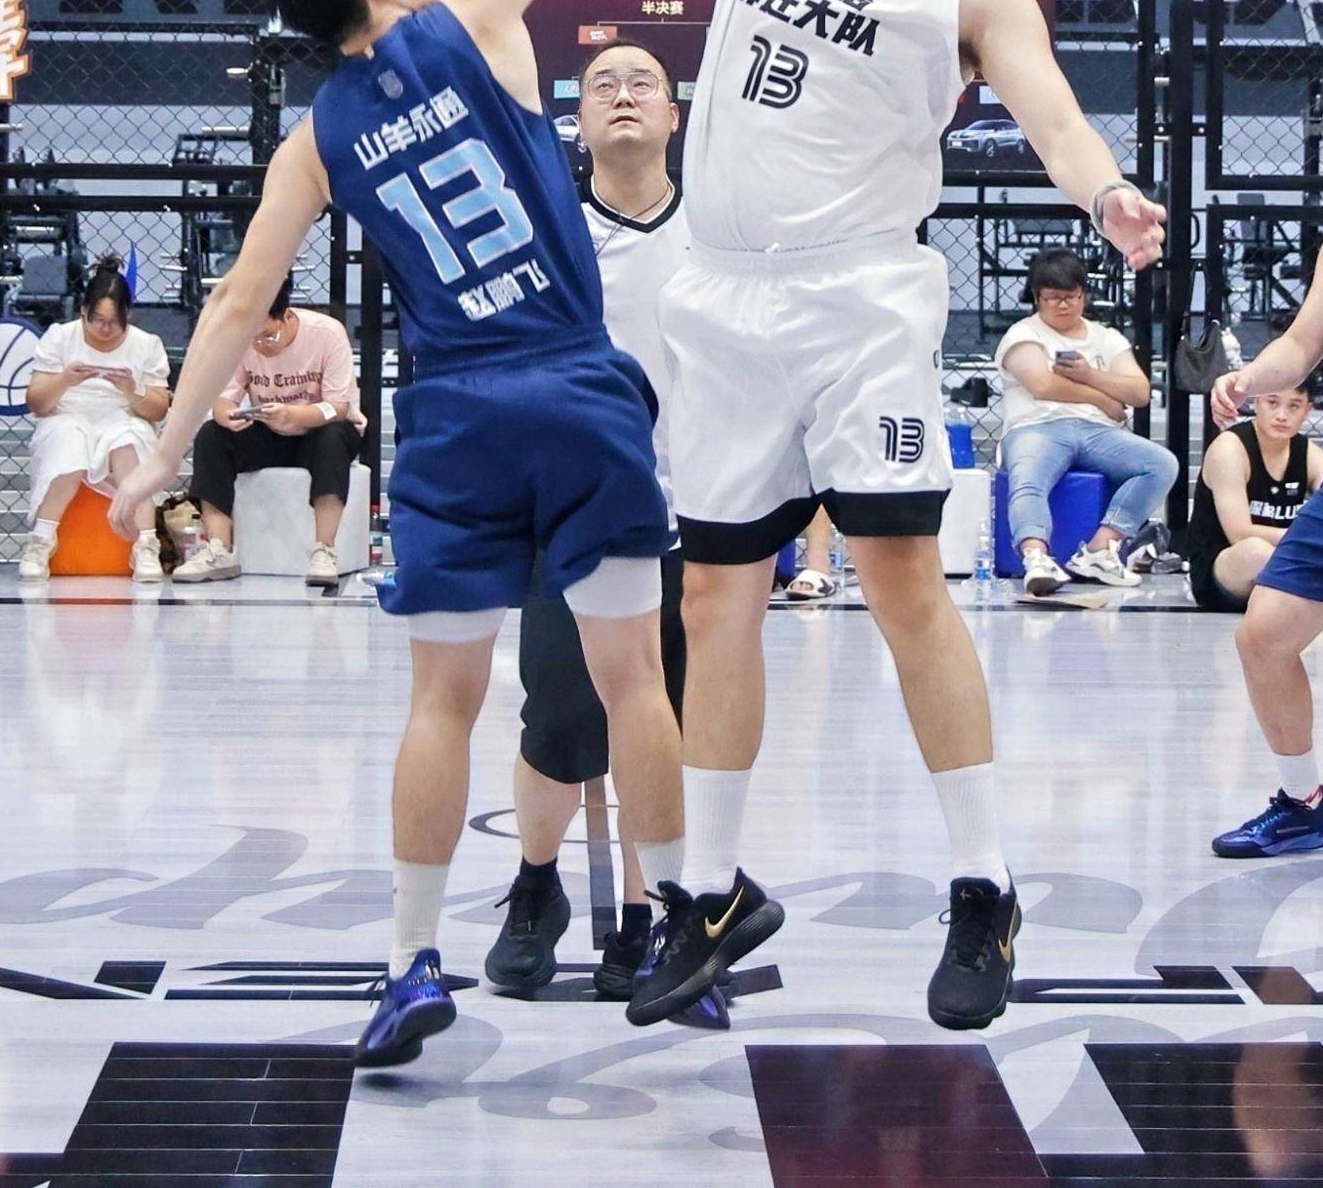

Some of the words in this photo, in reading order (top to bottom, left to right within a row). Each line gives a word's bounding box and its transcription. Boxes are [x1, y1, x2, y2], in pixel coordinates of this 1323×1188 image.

[641, 0, 684, 16] 半决赛
[741, 34, 810, 110] 13
[376, 137, 534, 286] 13
[879, 416, 925, 464] 13
